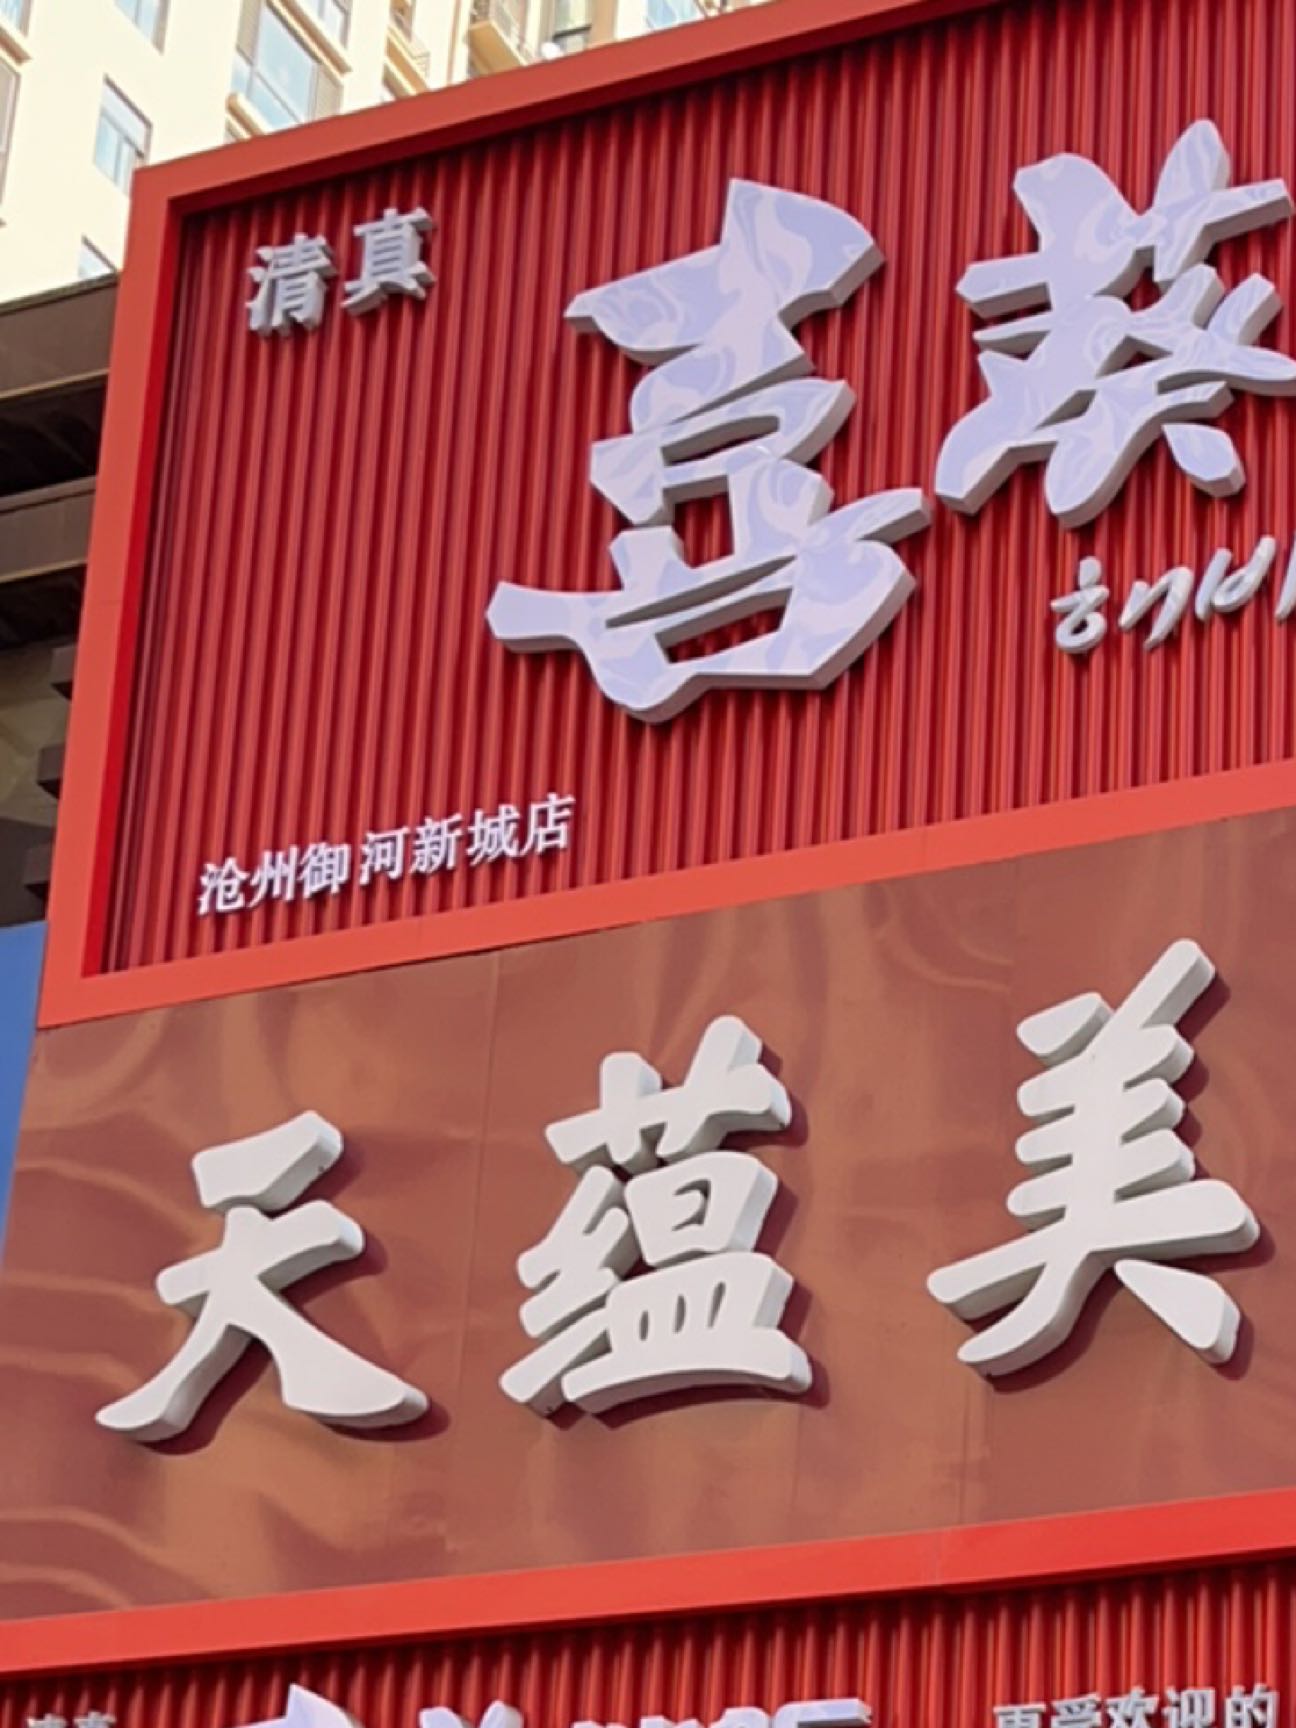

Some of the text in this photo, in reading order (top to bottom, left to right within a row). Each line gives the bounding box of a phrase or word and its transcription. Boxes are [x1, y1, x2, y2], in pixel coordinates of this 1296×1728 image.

[246, 206, 435, 336] 清真
[196, 793, 576, 916] 沧州御河新城店
